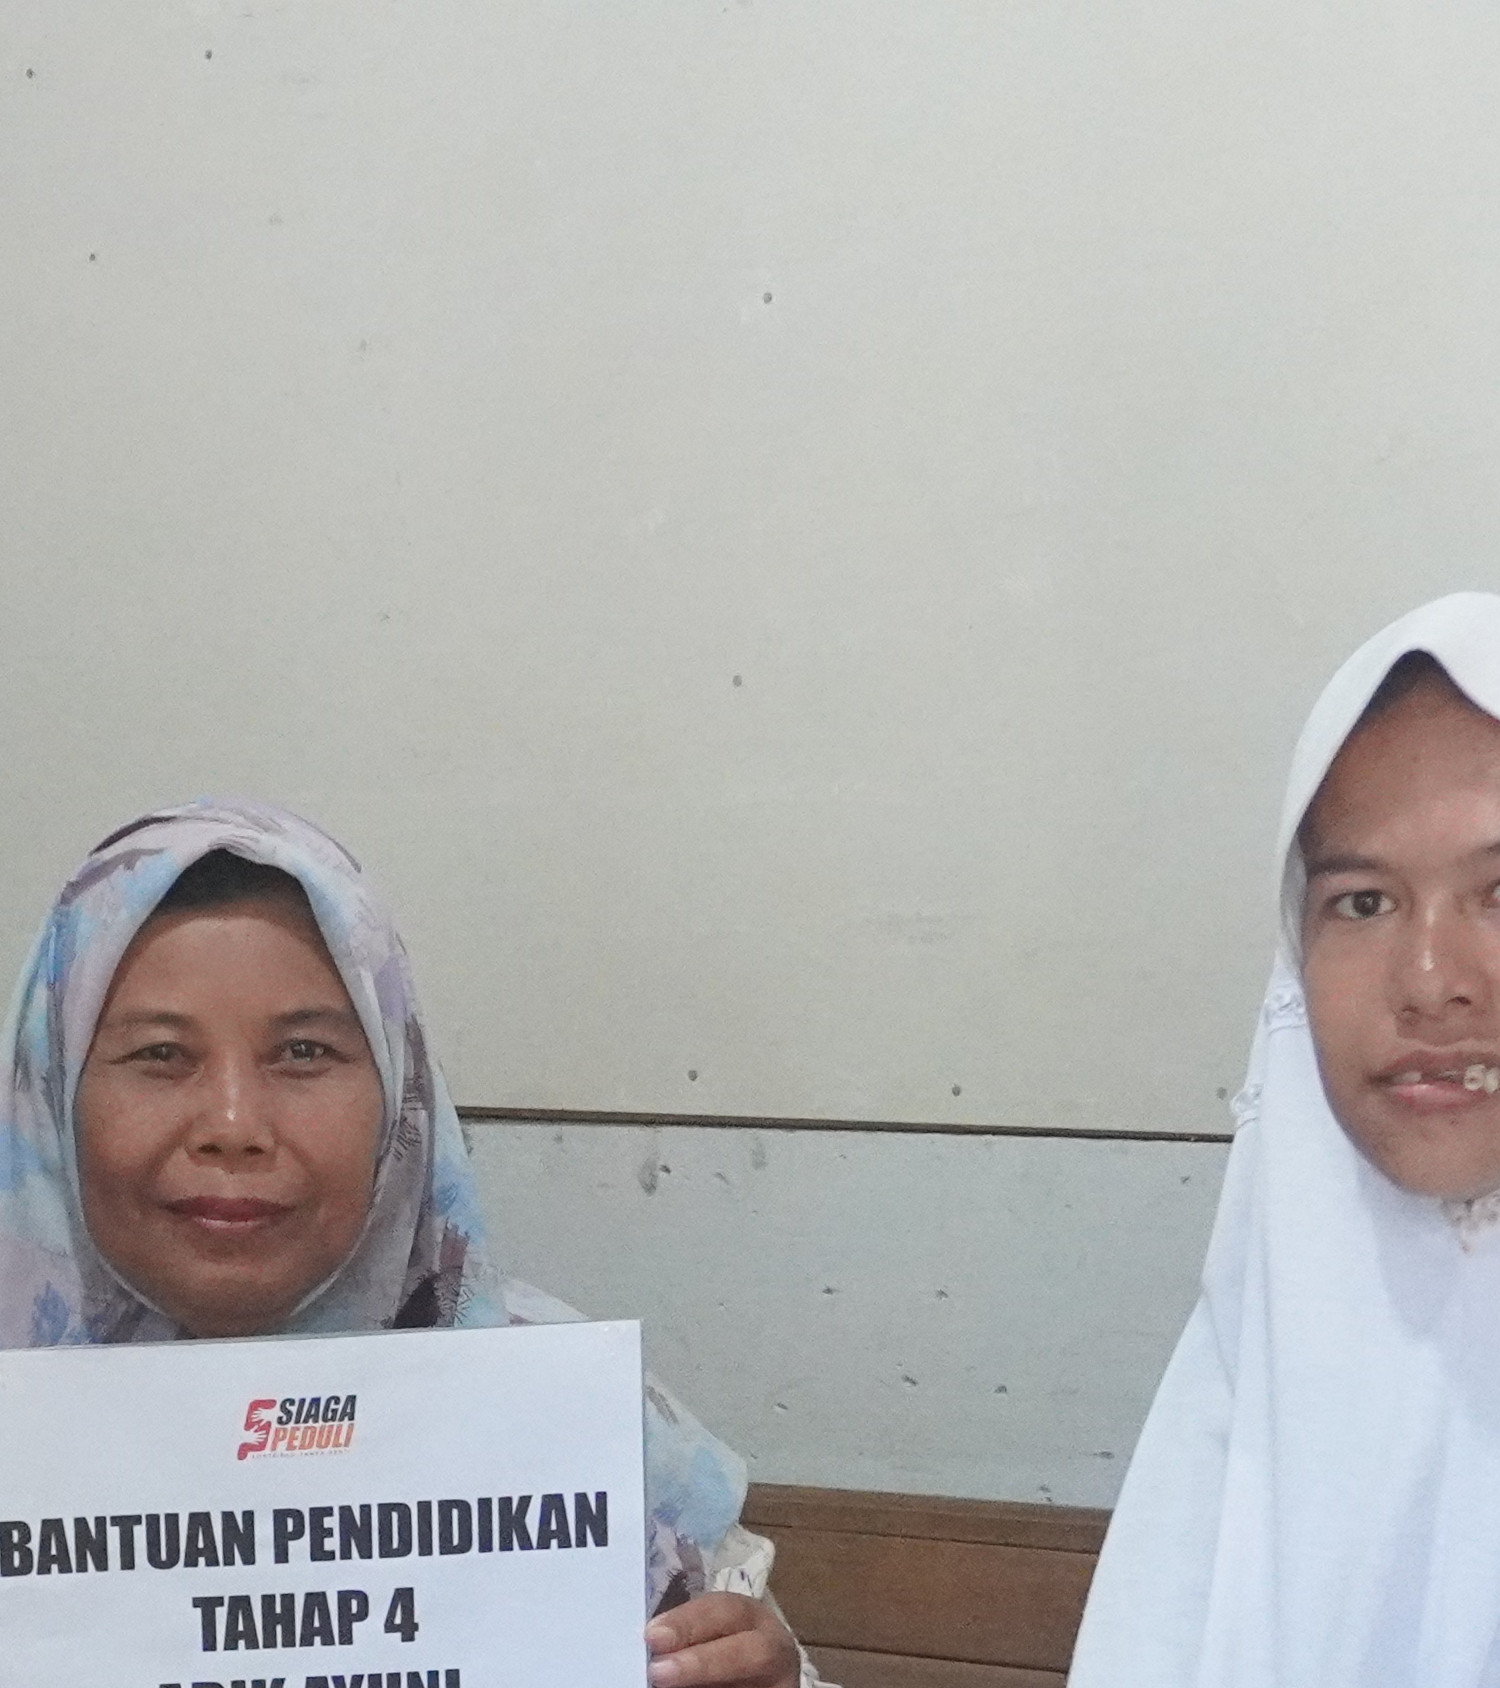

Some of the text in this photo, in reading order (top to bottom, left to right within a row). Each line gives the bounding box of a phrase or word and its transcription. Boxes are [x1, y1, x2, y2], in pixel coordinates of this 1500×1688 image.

[276, 1395, 357, 1426] SIAGA
[270, 1423, 355, 1452] PEDULI
[272, 1491, 610, 1564] PENDIDIKAN
[191, 1587, 419, 1653] TAHAP 4
